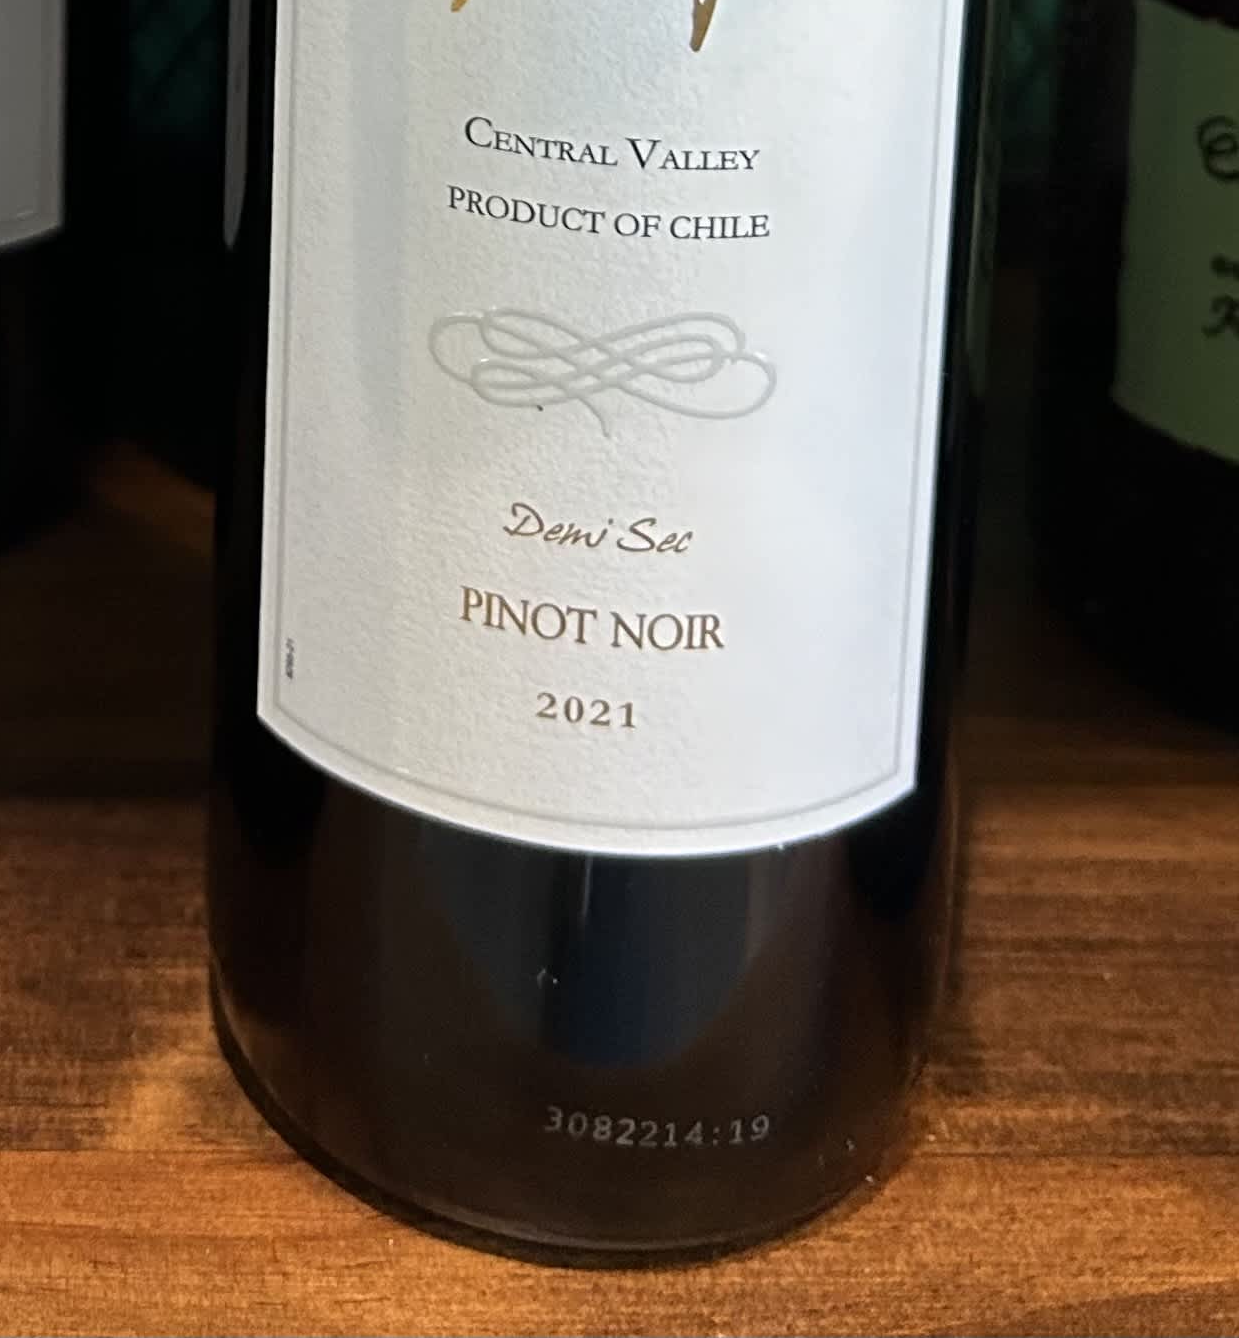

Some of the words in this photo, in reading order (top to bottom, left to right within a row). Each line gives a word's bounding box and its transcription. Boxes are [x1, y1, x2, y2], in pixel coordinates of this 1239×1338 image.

[464, 115, 618, 167] CENTRAL
[625, 137, 761, 171] VALLEY
[447, 185, 605, 236] PRODUCT
[613, 212, 660, 238] OF
[668, 214, 770, 240] CHILE
[502, 502, 613, 548] Demi
[617, 517, 694, 554] Sec
[460, 585, 597, 646] PINOT
[610, 611, 725, 652] NOIR
[536, 692, 636, 728] 2021
